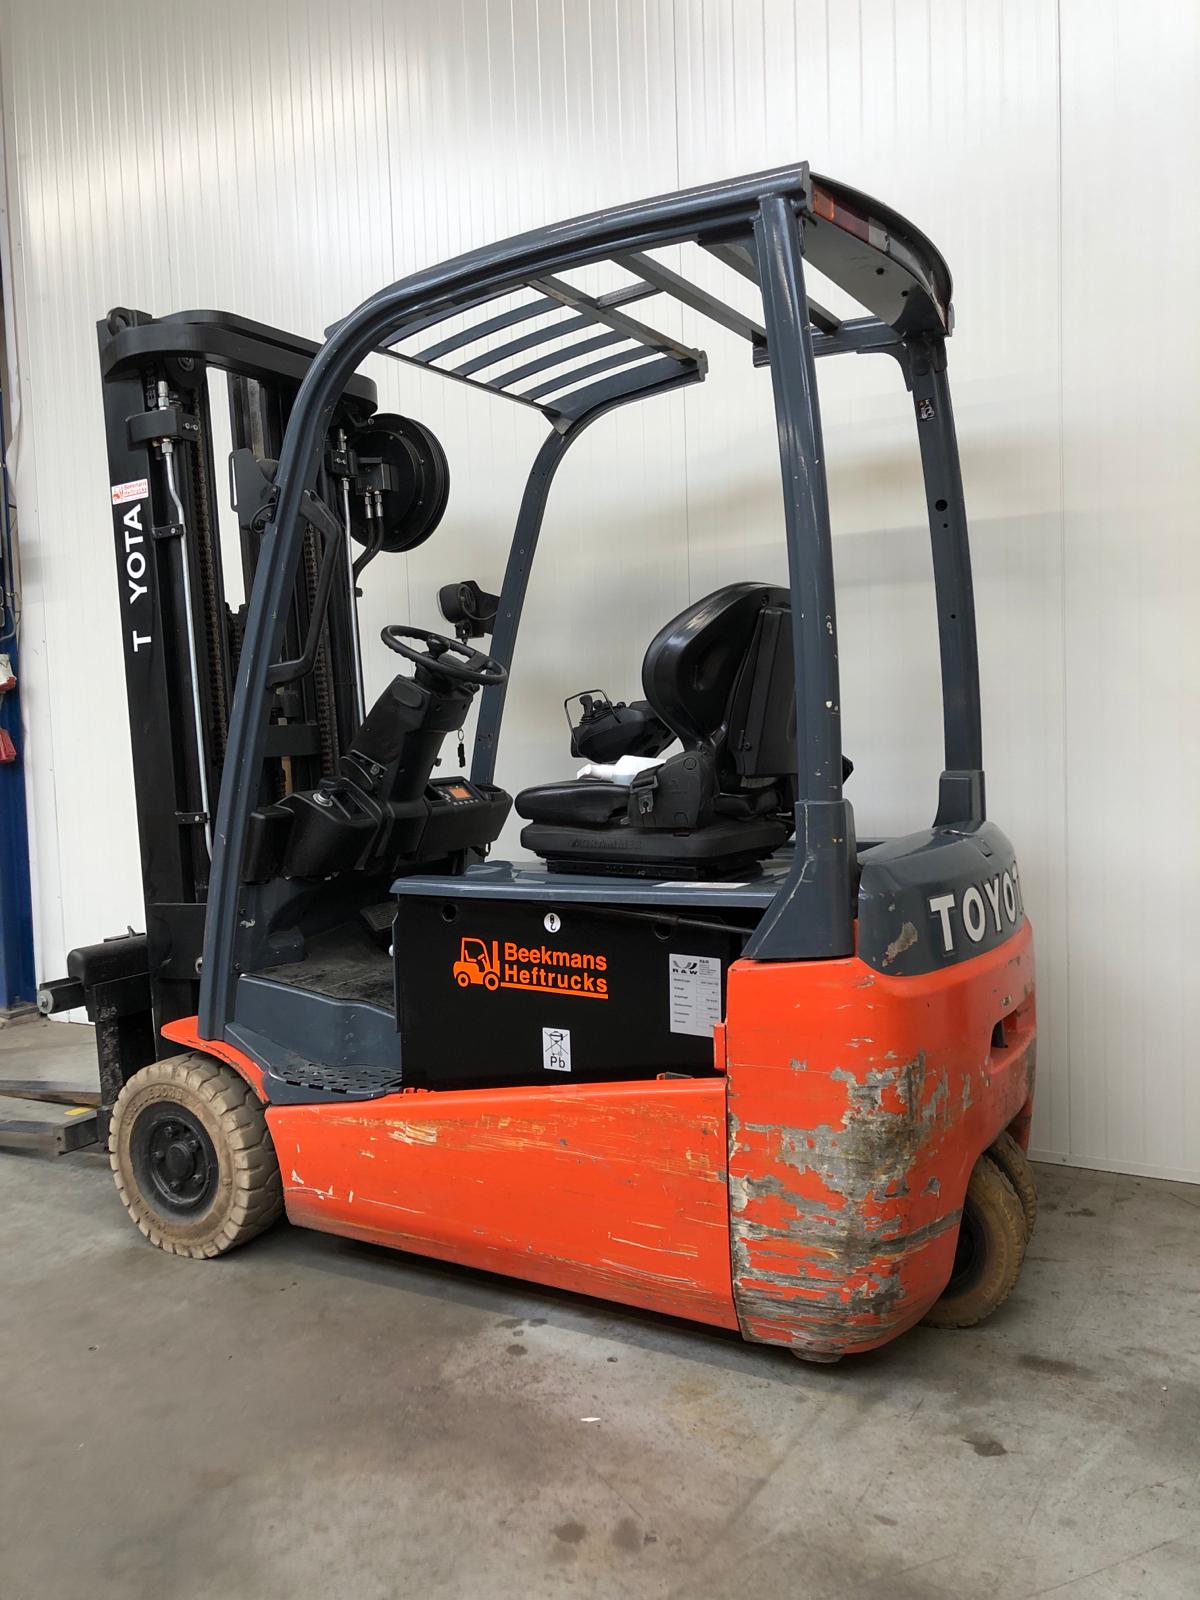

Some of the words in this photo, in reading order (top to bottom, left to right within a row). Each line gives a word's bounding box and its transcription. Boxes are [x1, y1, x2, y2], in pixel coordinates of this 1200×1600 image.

[504, 942, 608, 972] Beekmans
[504, 963, 608, 993] Heftrucks
[549, 1055, 566, 1069] Pb
